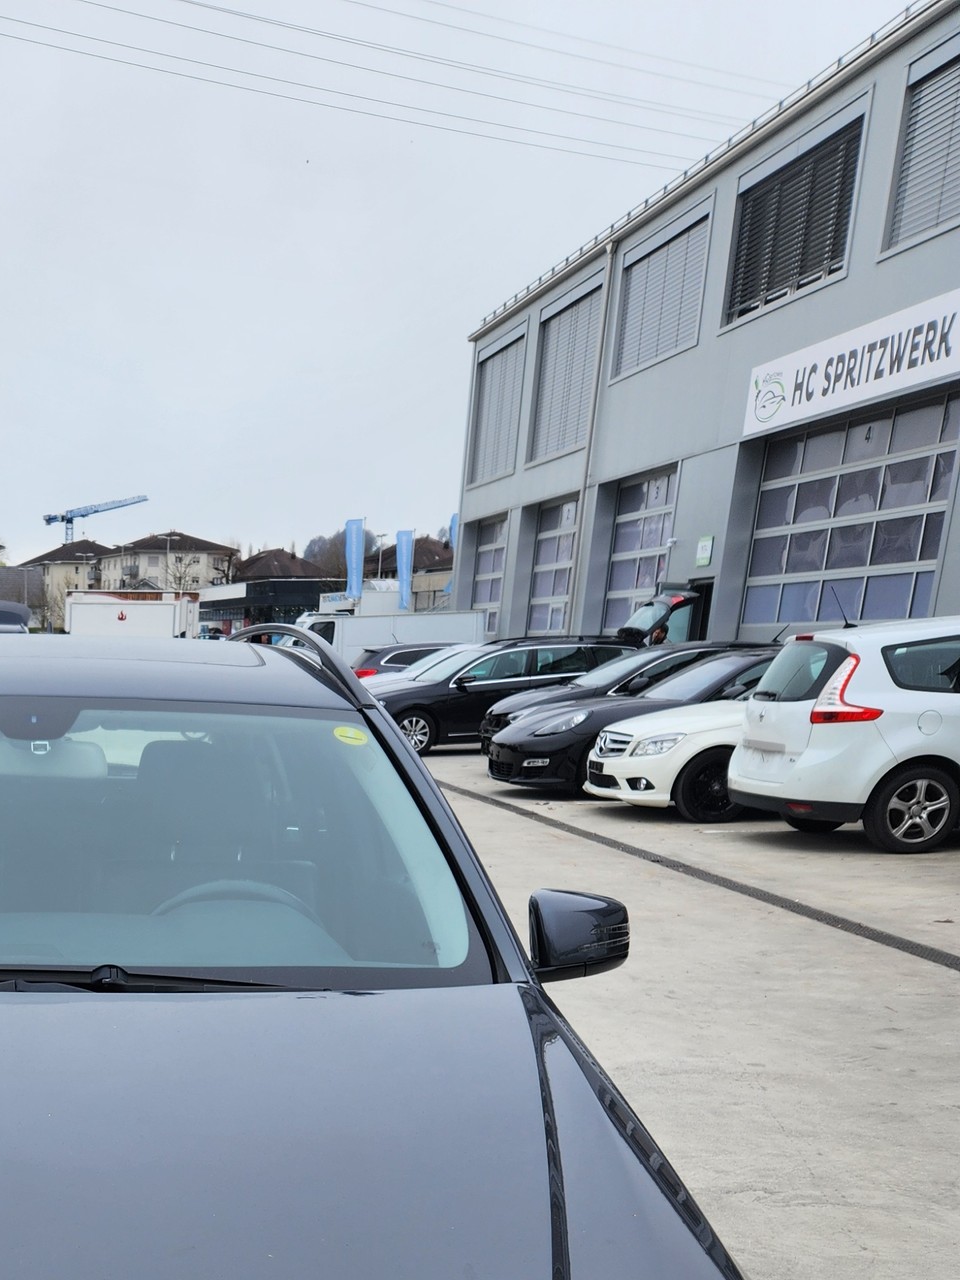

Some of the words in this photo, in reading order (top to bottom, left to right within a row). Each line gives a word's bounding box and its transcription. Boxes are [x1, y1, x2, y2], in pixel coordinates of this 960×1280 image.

[791, 362, 818, 407] HC
[821, 312, 957, 397] SPRITZWERK
[864, 425, 872, 444] 4
